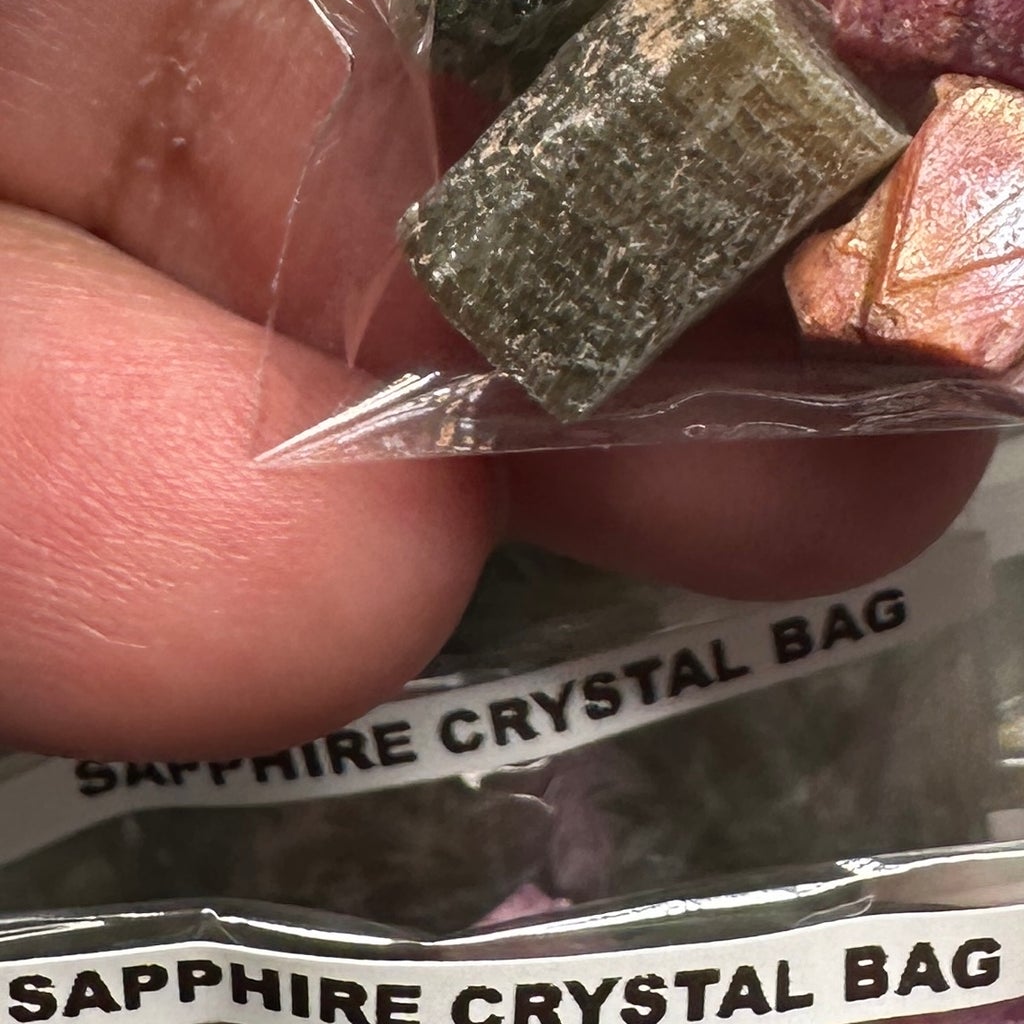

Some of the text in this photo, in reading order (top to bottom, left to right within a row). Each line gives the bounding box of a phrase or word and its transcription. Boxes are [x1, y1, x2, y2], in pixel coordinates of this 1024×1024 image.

[439, 638, 751, 755] CRYSTAL
[770, 588, 906, 666] BAG
[8, 937, 1002, 1024] SAPPHIRE CRYSTAL BAG
